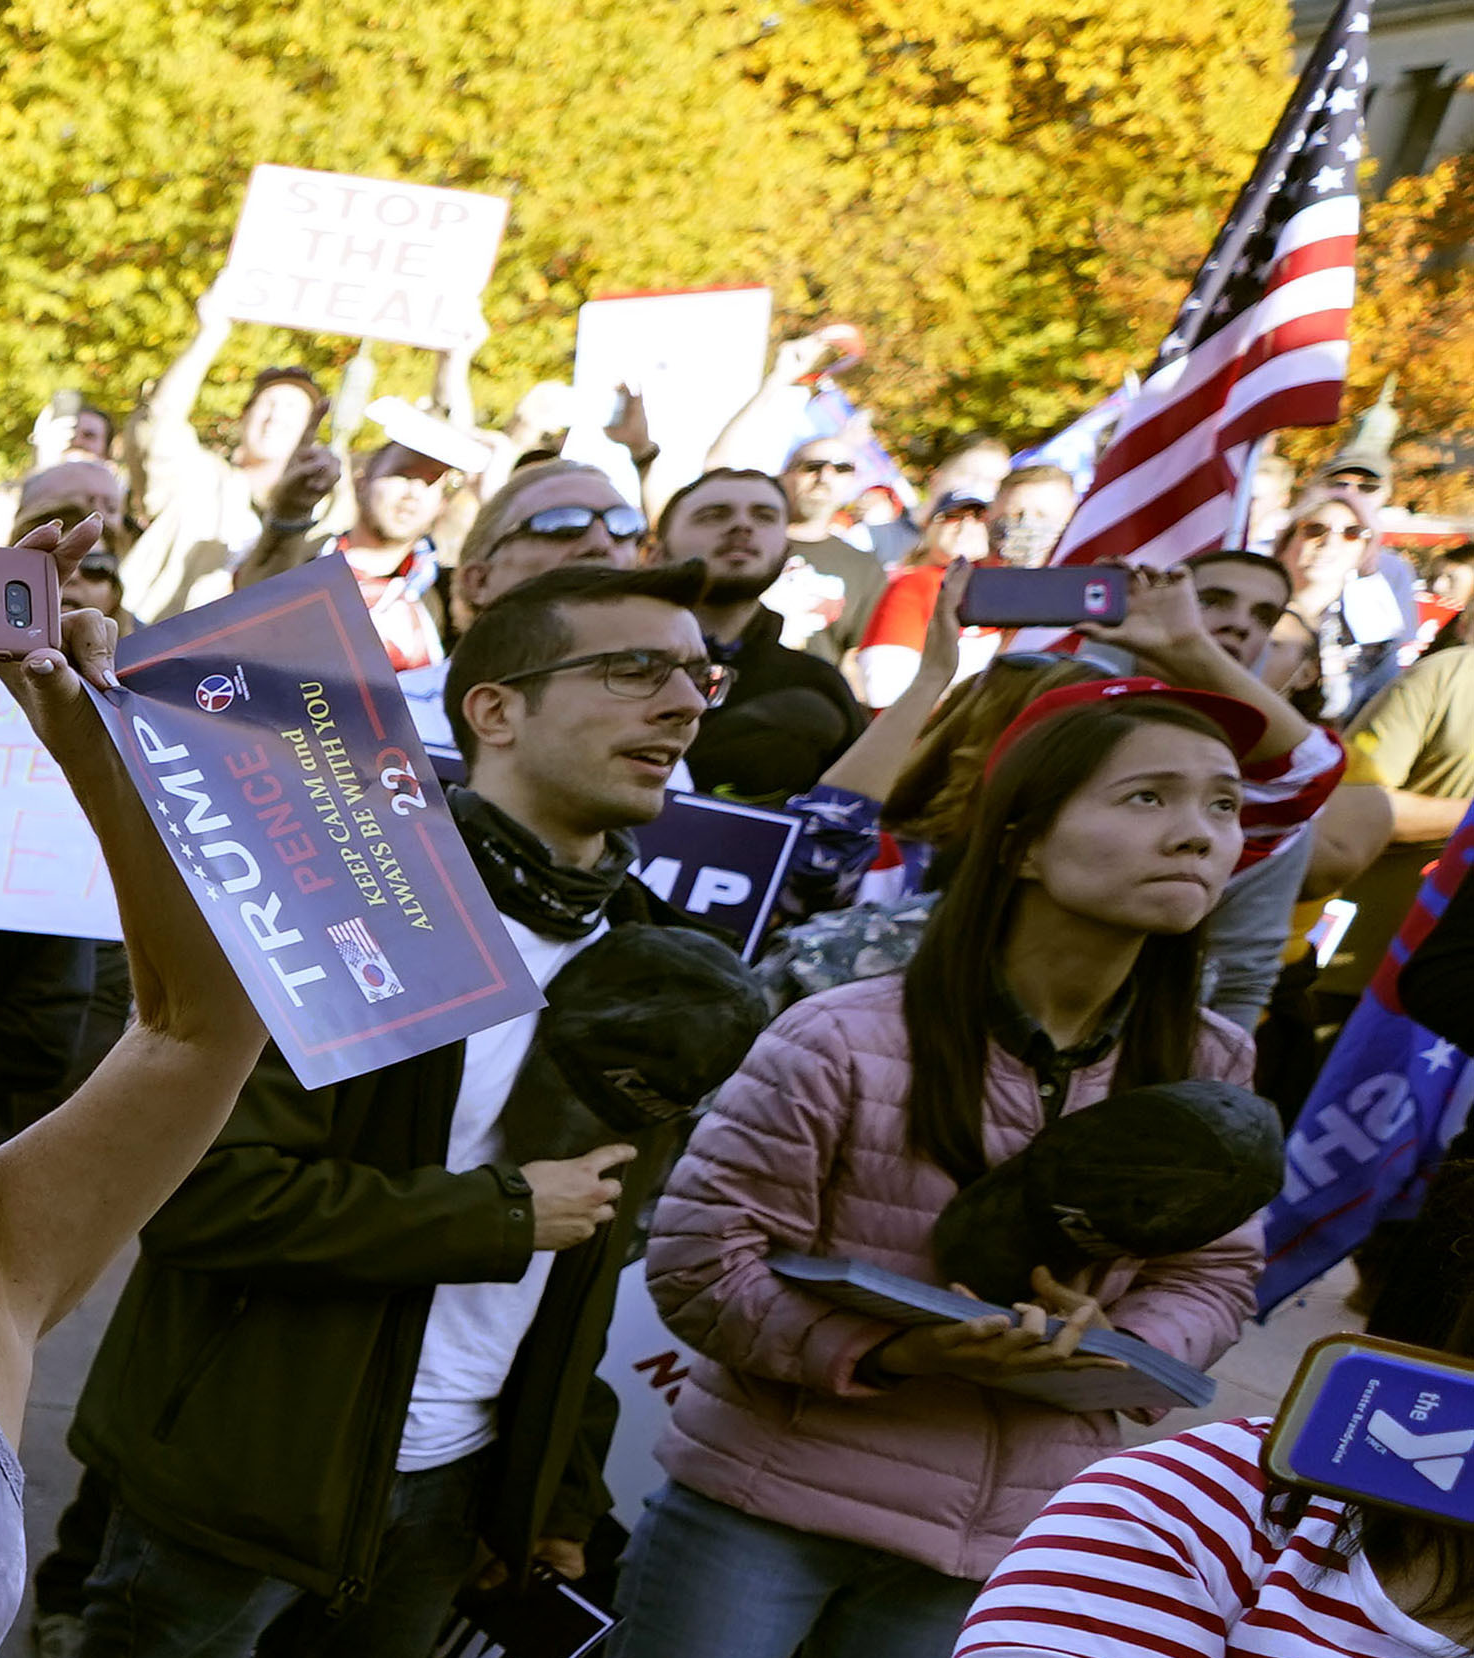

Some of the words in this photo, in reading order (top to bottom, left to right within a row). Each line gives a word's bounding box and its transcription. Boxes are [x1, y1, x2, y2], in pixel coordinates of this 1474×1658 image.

[287, 181, 470, 231] STOP
[301, 227, 435, 278] THE
[299, 681, 336, 738] YOU
[280, 727, 317, 773] and
[320, 737, 366, 806] WITH
[225, 743, 336, 895] PENCE
[303, 775, 352, 844] CALM
[354, 808, 384, 839] BE
[132, 715, 327, 1008] TRUMP
[341, 848, 389, 907] KEEP
[369, 841, 434, 931] ALWAYS
[1409, 1391, 1441, 1422] the
